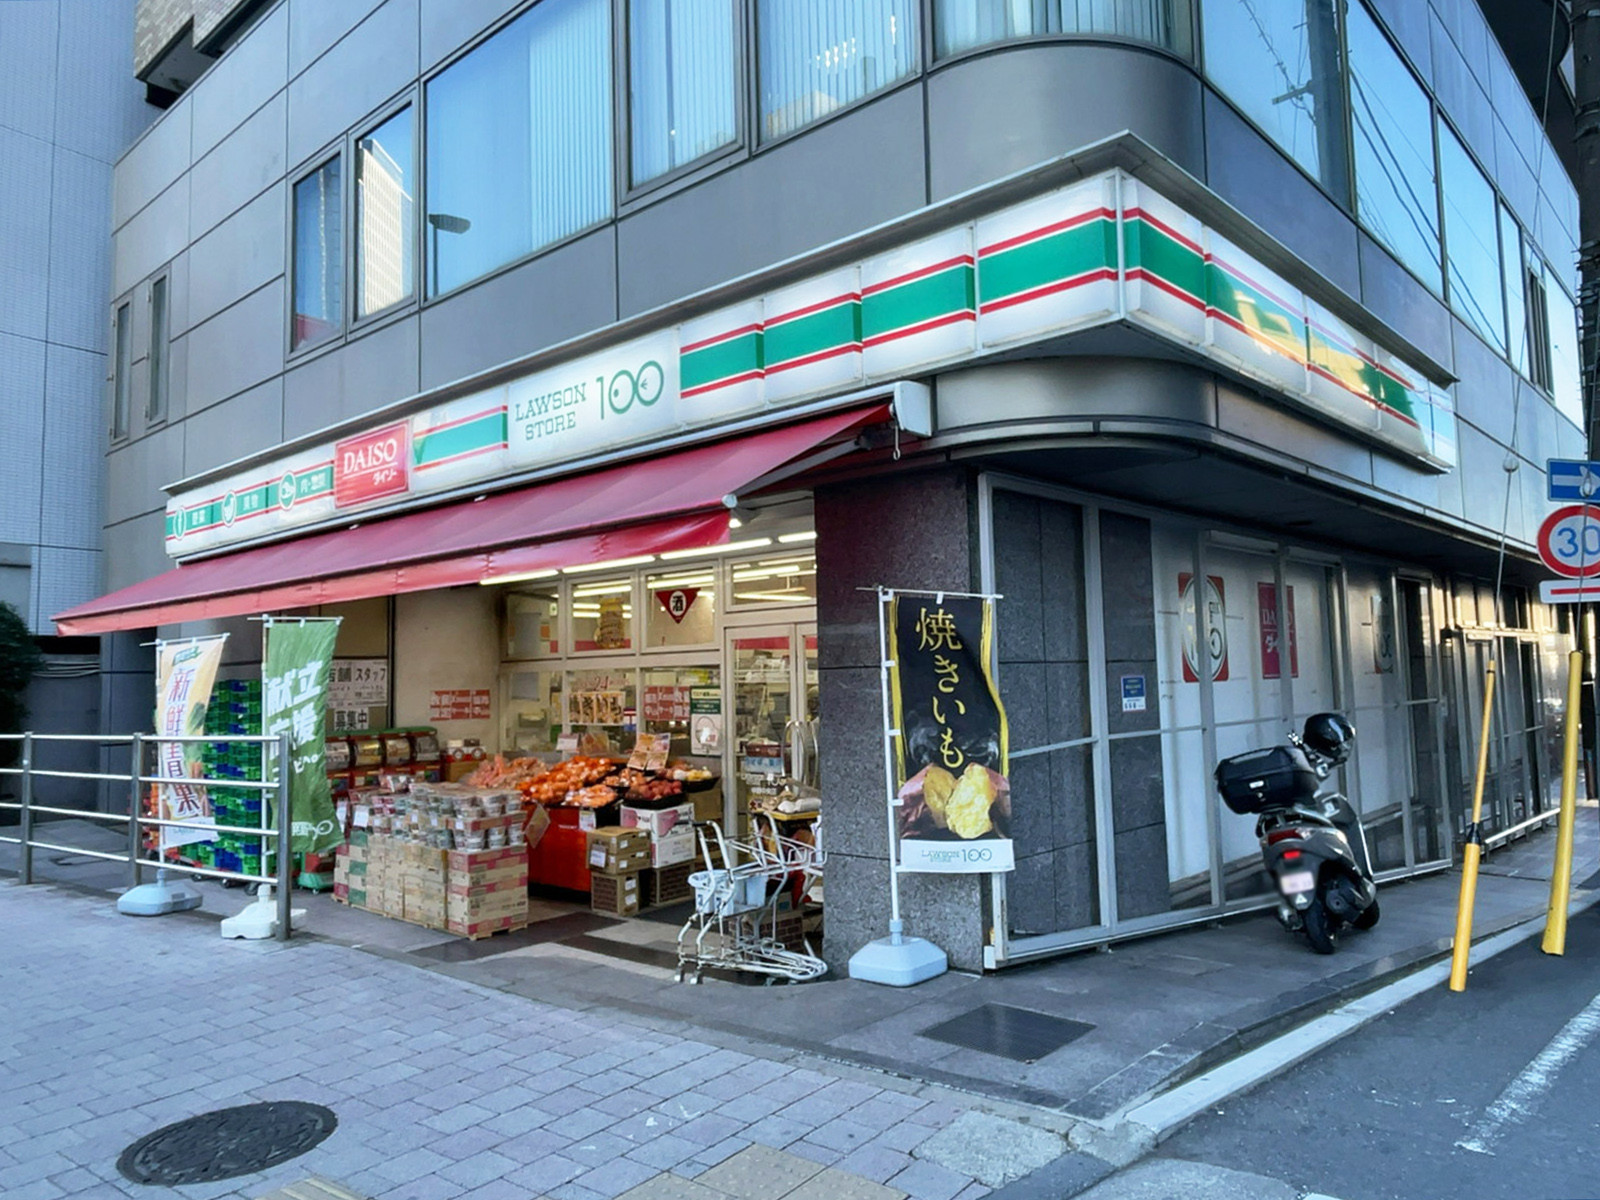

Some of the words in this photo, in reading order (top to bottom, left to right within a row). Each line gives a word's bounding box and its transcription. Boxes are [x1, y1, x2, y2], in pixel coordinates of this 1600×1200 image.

[515, 382, 587, 422] LAWSON
[596, 360, 665, 420] 100
[525, 411, 576, 441] STORE
[343, 438, 398, 475] DAISO
[1557, 525, 1600, 558] 30
[355, 667, 386, 681] スタッフ
[915, 606, 967, 769] 焼きいも
[335, 709, 368, 730] 募集中
[962, 847, 992, 862] 100
